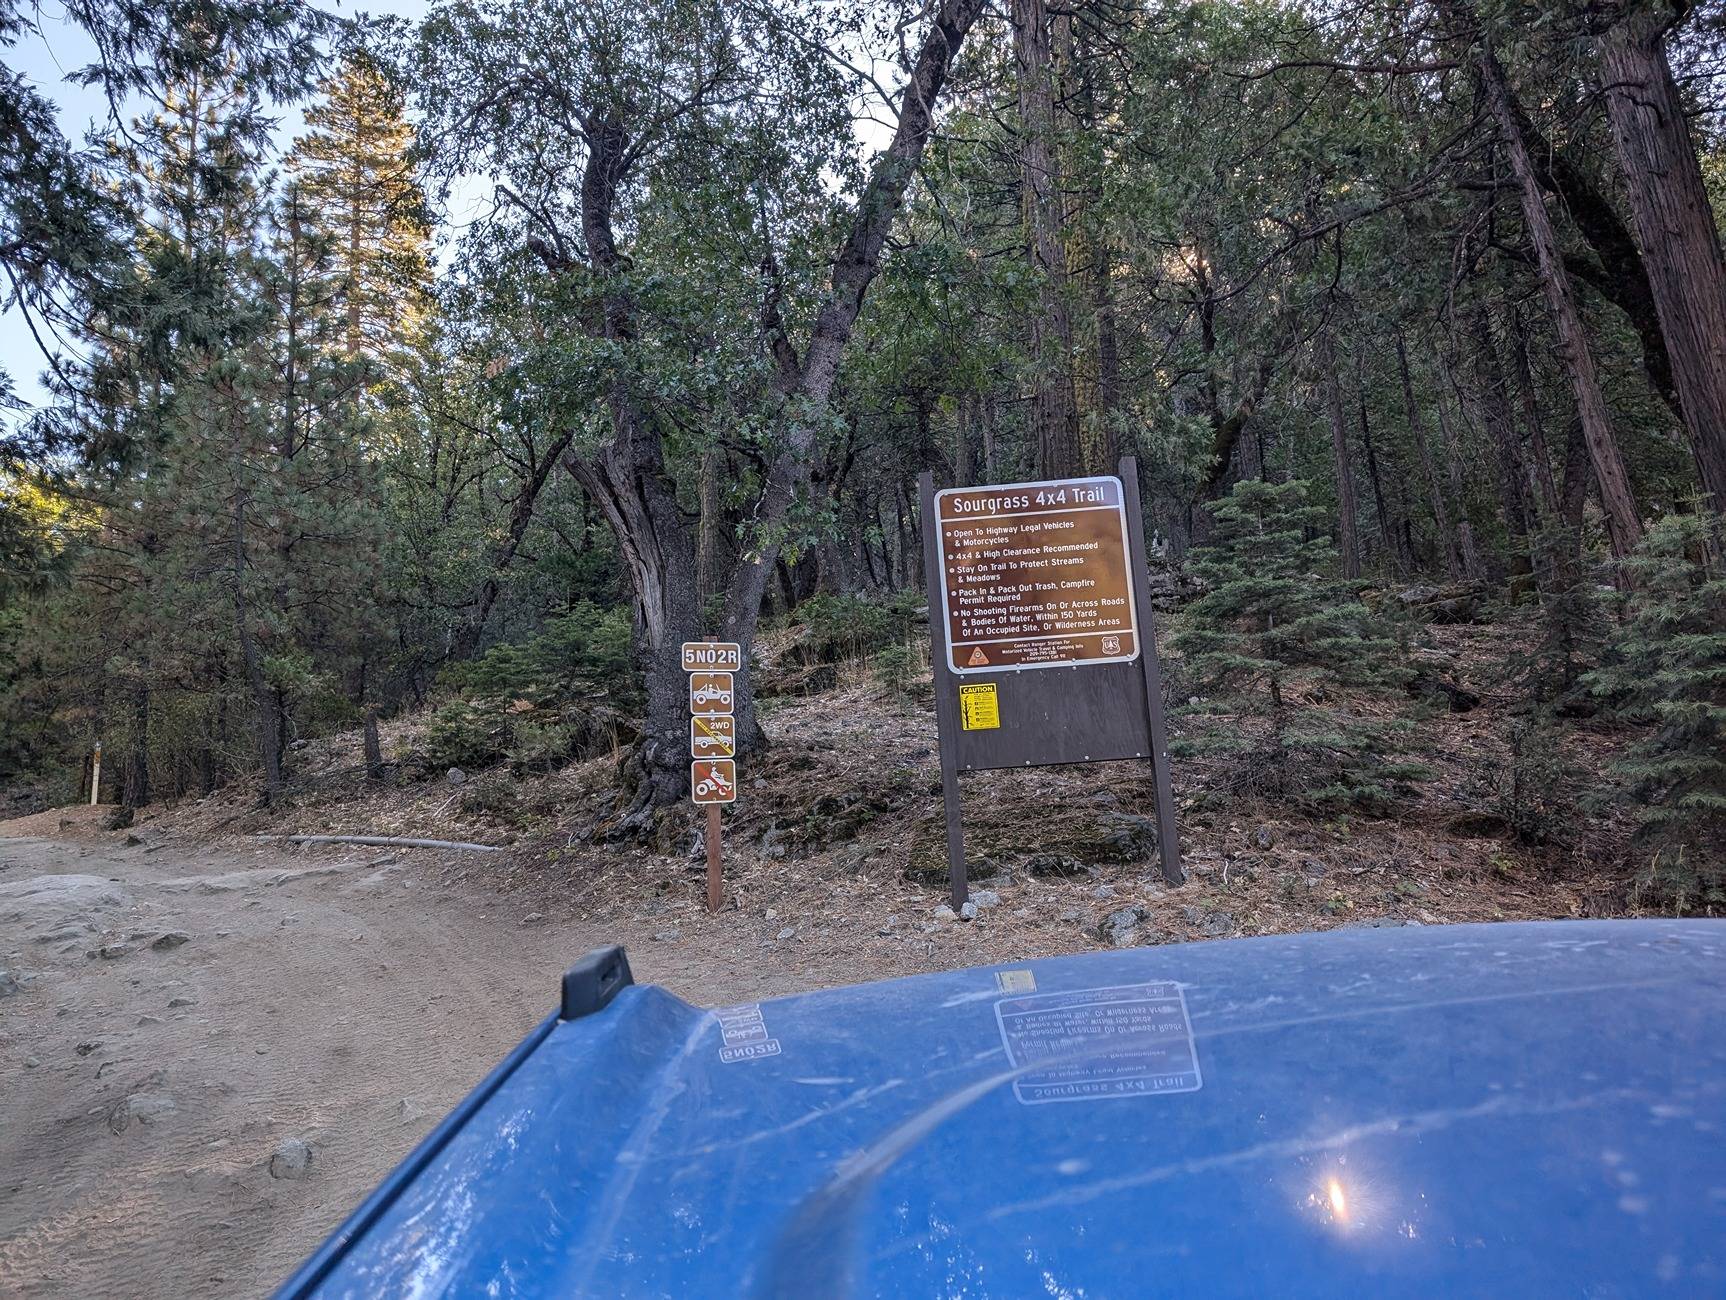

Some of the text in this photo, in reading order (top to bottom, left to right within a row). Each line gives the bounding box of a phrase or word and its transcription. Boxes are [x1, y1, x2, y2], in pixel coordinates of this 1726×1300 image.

[954, 487, 1104, 514] Sourgrass 4x4 Trail
[987, 526, 1017, 536] Highway
[1021, 524, 1040, 533] Legal
[1044, 521, 1074, 530] Vehicles
[964, 536, 1009, 546] Motorcycles
[984, 550, 1000, 559] High
[1003, 547, 1040, 556] Clearance
[1044, 542, 1098, 553] Recommended
[957, 566, 974, 575] Stay
[1036, 582, 1058, 590] Trash,
[1061, 579, 1095, 589] Campfire
[960, 594, 1021, 605] Permit Required
[974, 607, 1006, 616] Shooting
[1010, 604, 1043, 612] Firearms
[987, 626, 1020, 636] Occupied
[1056, 620, 1095, 629] Wilderness
[686, 650, 737, 664] 5N02R
